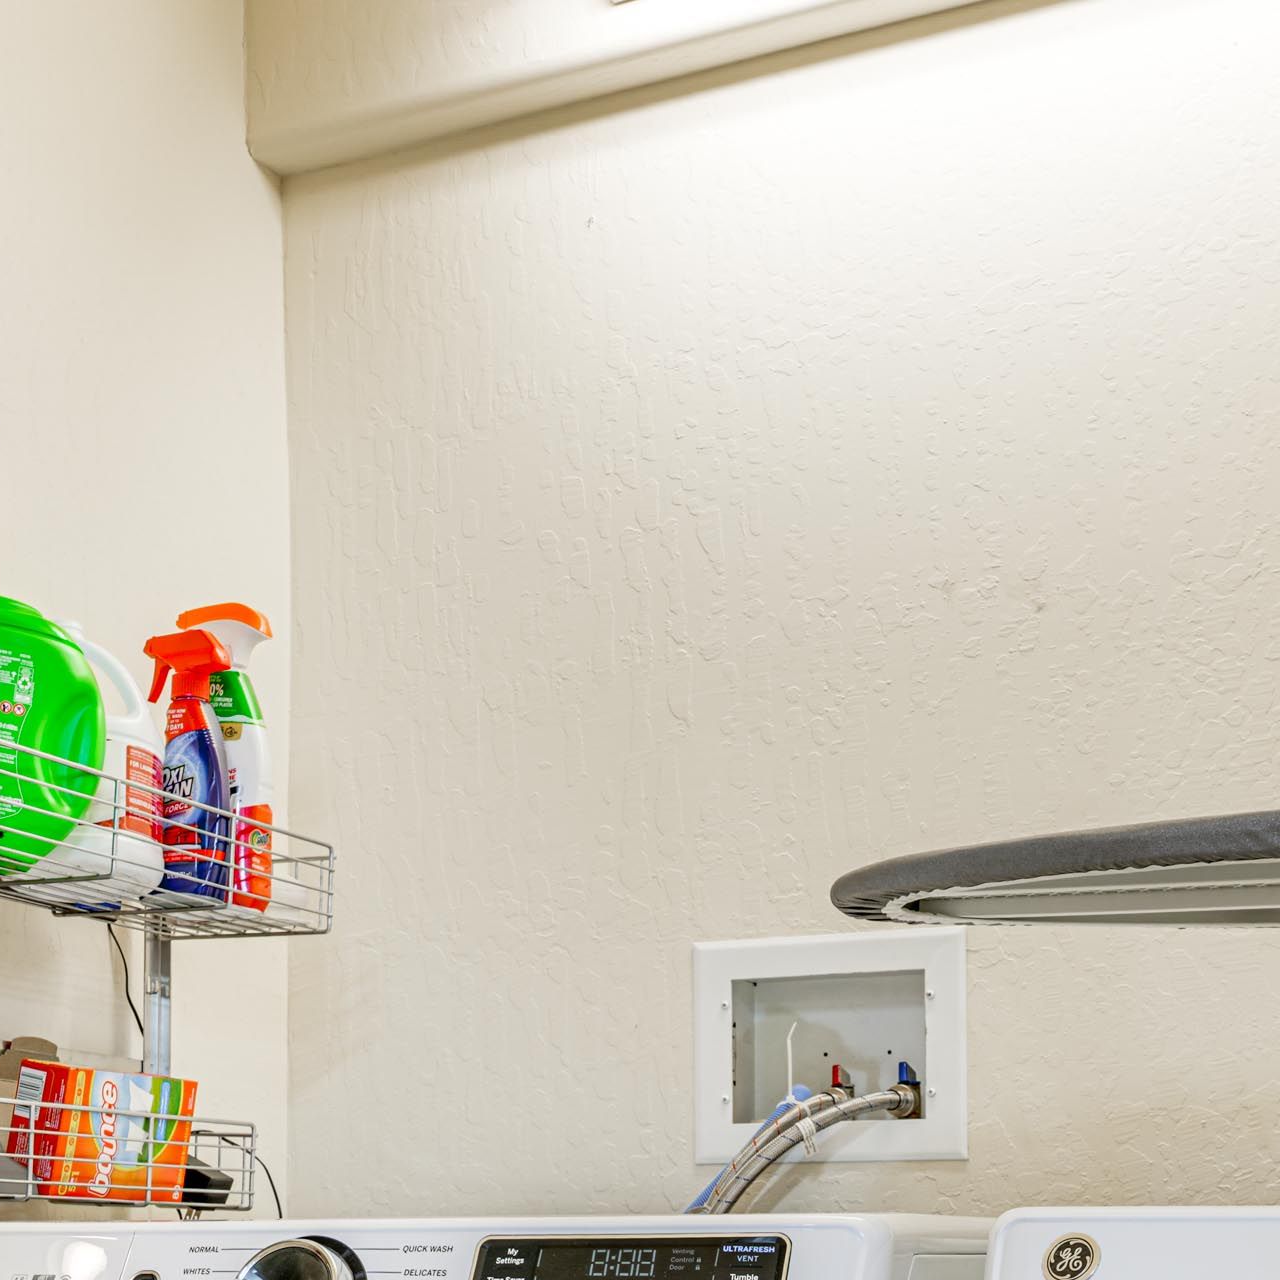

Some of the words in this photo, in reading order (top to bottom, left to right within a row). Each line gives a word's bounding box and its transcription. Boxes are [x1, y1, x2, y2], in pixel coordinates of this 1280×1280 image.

[209, 683, 224, 697] 0%
[88, 1081, 118, 1197] bounce
[189, 1246, 220, 1254] NORMAL
[402, 1245, 428, 1254] QUICK
[429, 1245, 454, 1253] WASH
[507, 1248, 519, 1257] My
[722, 1245, 776, 1253] ULTRAFRESH
[495, 1257, 525, 1266] Settings
[403, 1269, 447, 1277] DELICATES
[729, 1273, 759, 1280] Tumble
